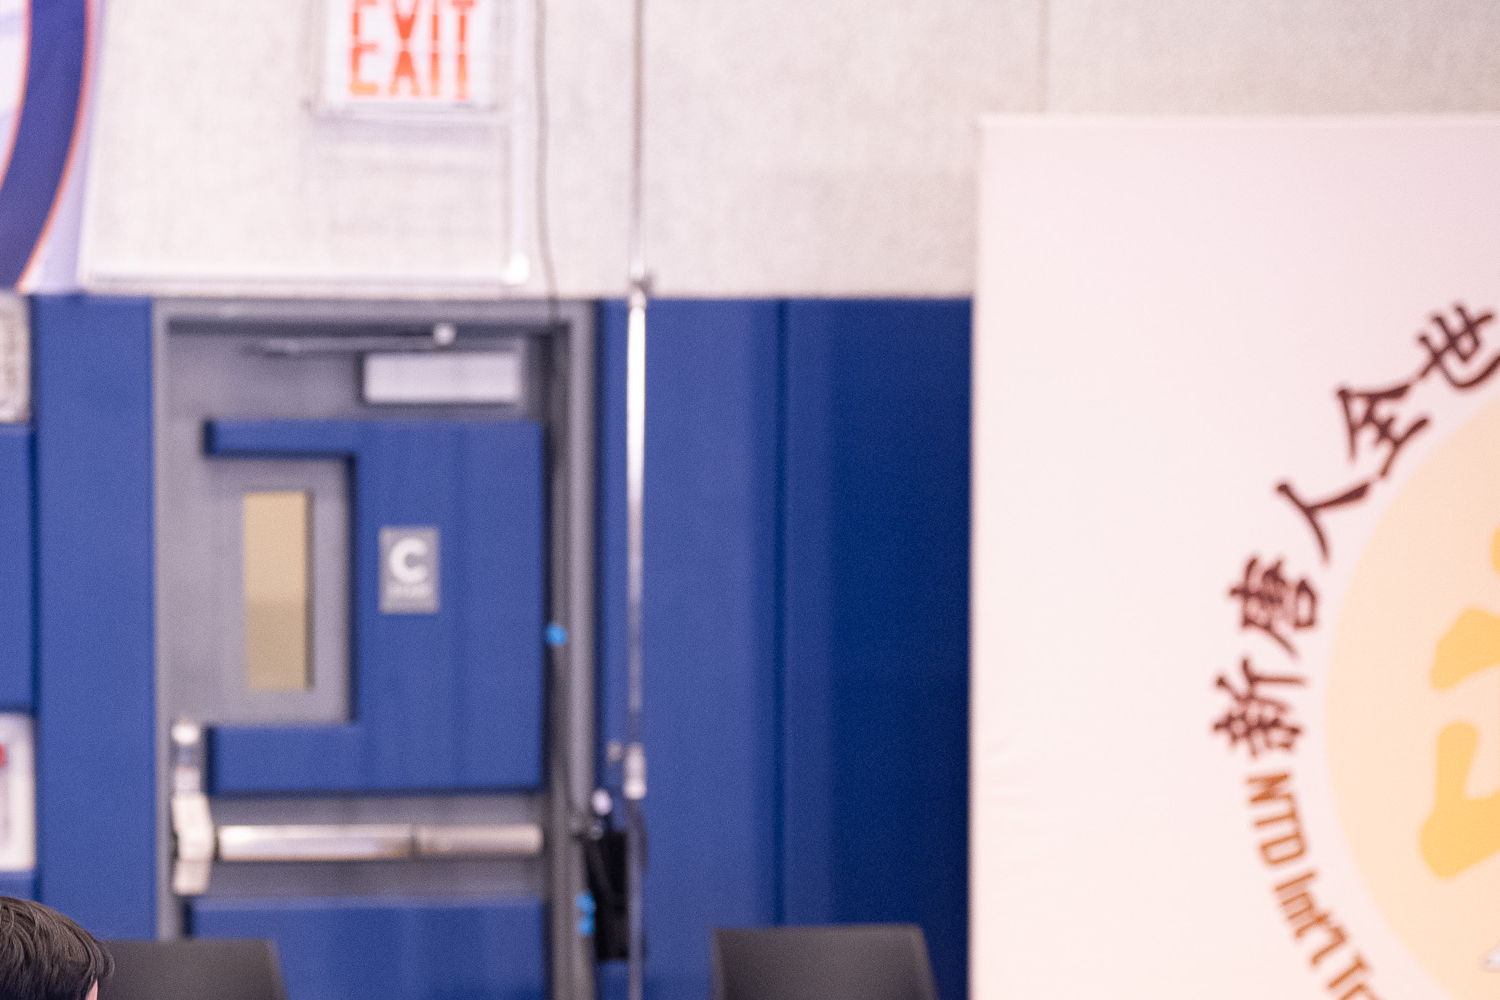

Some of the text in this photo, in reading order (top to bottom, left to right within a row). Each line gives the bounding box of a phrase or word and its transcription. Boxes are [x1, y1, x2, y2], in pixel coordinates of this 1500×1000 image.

[349, 0, 476, 99] EXIT
[389, 537, 428, 582] C
[1246, 771, 1306, 866] NTD
